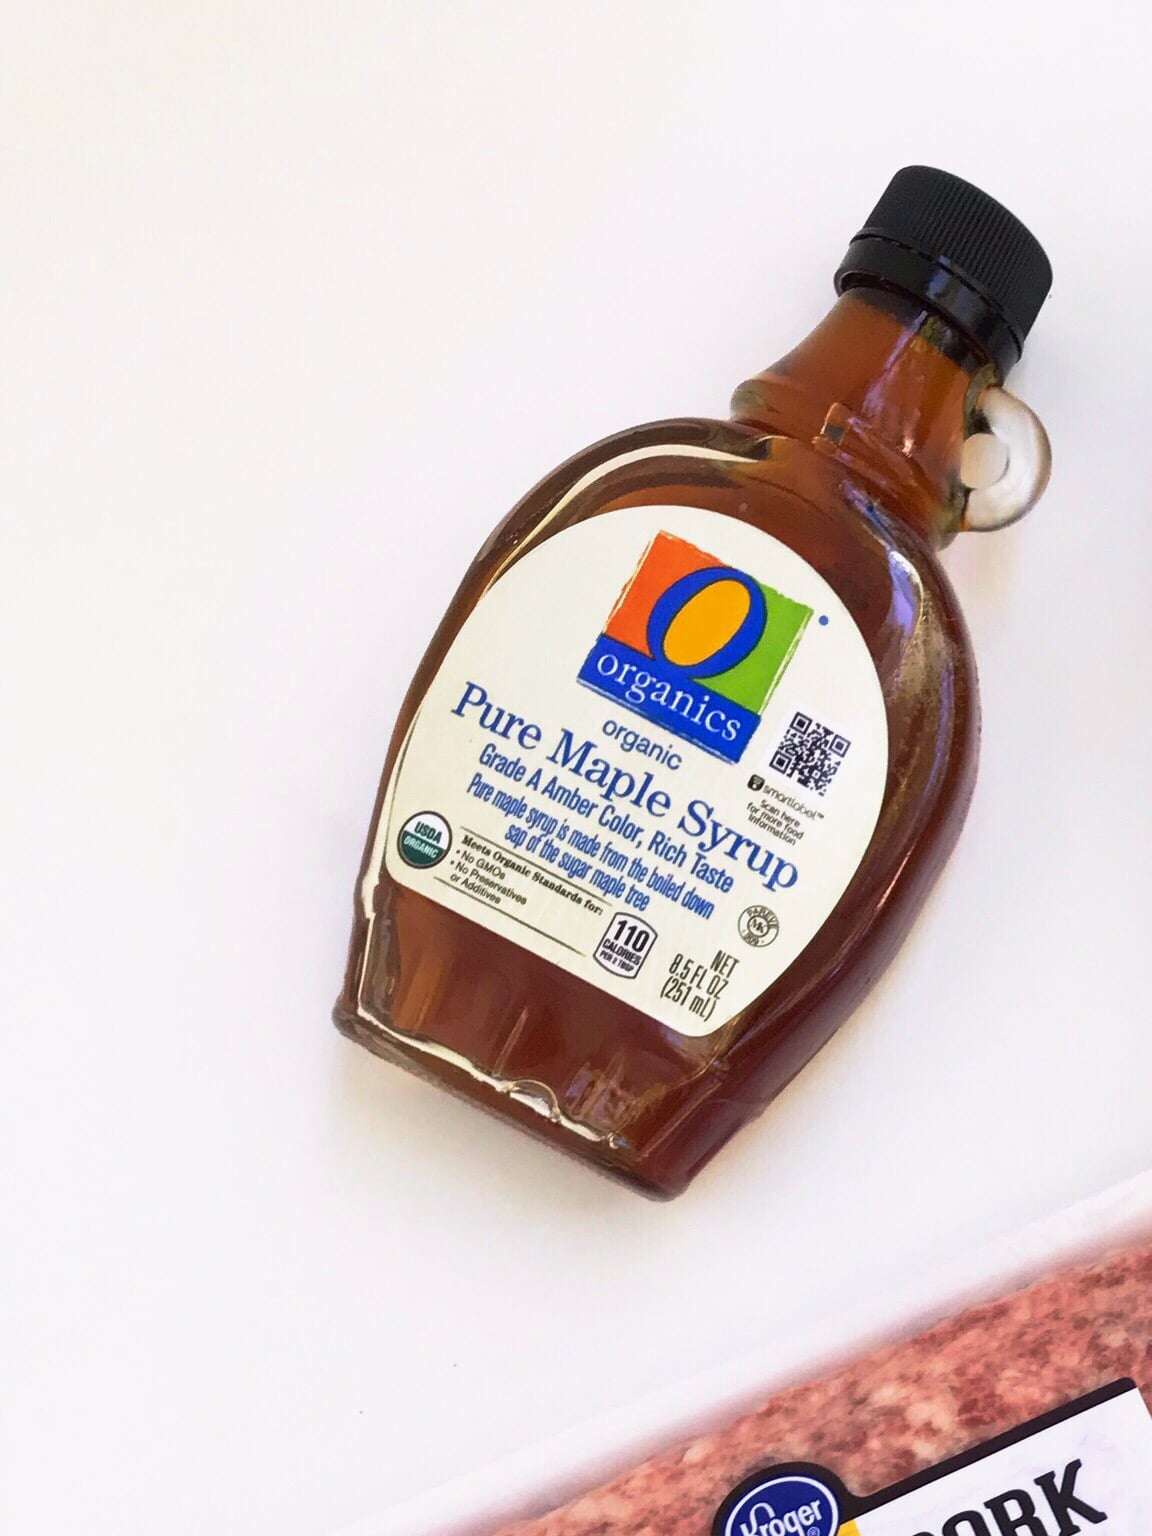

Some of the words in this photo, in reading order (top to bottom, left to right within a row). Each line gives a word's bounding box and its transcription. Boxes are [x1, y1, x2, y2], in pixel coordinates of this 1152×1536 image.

[598, 655, 740, 740] organics
[602, 720, 682, 770] organic
[451, 682, 541, 749] Pure
[546, 728, 670, 817] Maple
[677, 800, 798, 892] Syrup
[413, 821, 444, 844] USDA
[480, 743, 526, 782] Grade
[526, 768, 542, 790] A
[541, 776, 598, 818] Amber
[599, 805, 644, 848] Color,
[648, 830, 686, 867] Rich
[690, 852, 733, 892] Taste
[403, 835, 439, 858] ORGANIC
[461, 850, 474, 863] No
[476, 859, 505, 880] GMOs
[467, 773, 494, 802] Pure
[492, 791, 527, 818] maple
[526, 808, 558, 837] syrup
[556, 819, 570, 841] is
[568, 830, 600, 857] made
[600, 842, 628, 872] from
[627, 858, 648, 882] the
[646, 867, 686, 902] boiled
[681, 888, 714, 919] down
[450, 874, 460, 882] or
[461, 878, 500, 904] Additives
[456, 862, 468, 874] No
[470, 869, 526, 904] Preservatives
[462, 835, 491, 856] Meets
[493, 852, 530, 876] Organic
[532, 872, 582, 904] Standards
[505, 825, 528, 848] sap
[526, 834, 545, 853] of
[539, 839, 560, 863] the
[558, 853, 592, 879] sugar
[590, 870, 626, 898] maple
[625, 884, 650, 911] tree
[600, 950, 612, 961] PER
[603, 939, 641, 965] CALORIES
[614, 920, 649, 952] 110
[669, 954, 694, 980] 8.5
[690, 965, 707, 989] FL
[706, 975, 728, 999] OZ
[710, 950, 739, 978] NET
[660, 976, 692, 1005] (251
[689, 996, 716, 1022] mL)
